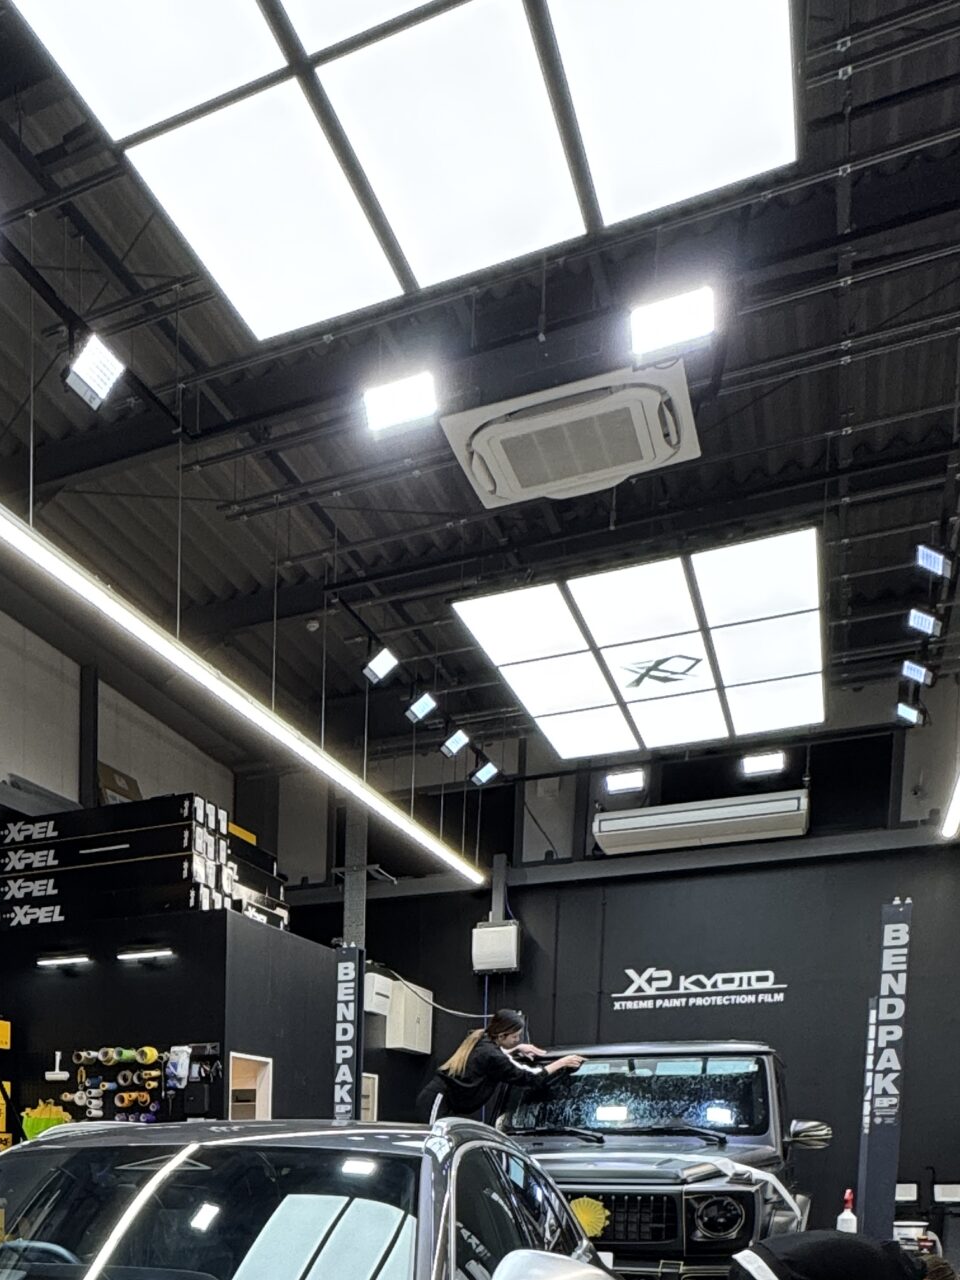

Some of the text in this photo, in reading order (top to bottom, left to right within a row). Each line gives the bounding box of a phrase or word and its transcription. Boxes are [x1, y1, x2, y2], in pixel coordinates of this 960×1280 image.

[3, 821, 58, 844] XPEL
[4, 849, 59, 871] XPEL
[3, 879, 58, 900] XPEL
[9, 905, 65, 926] XPEL
[679, 970, 775, 992] KYOTO
[613, 993, 784, 1010] XTREME PAINT PROTECTION FILM
[873, 923, 909, 1095] BENDPAK
[334, 962, 356, 1103] BENDPAK
